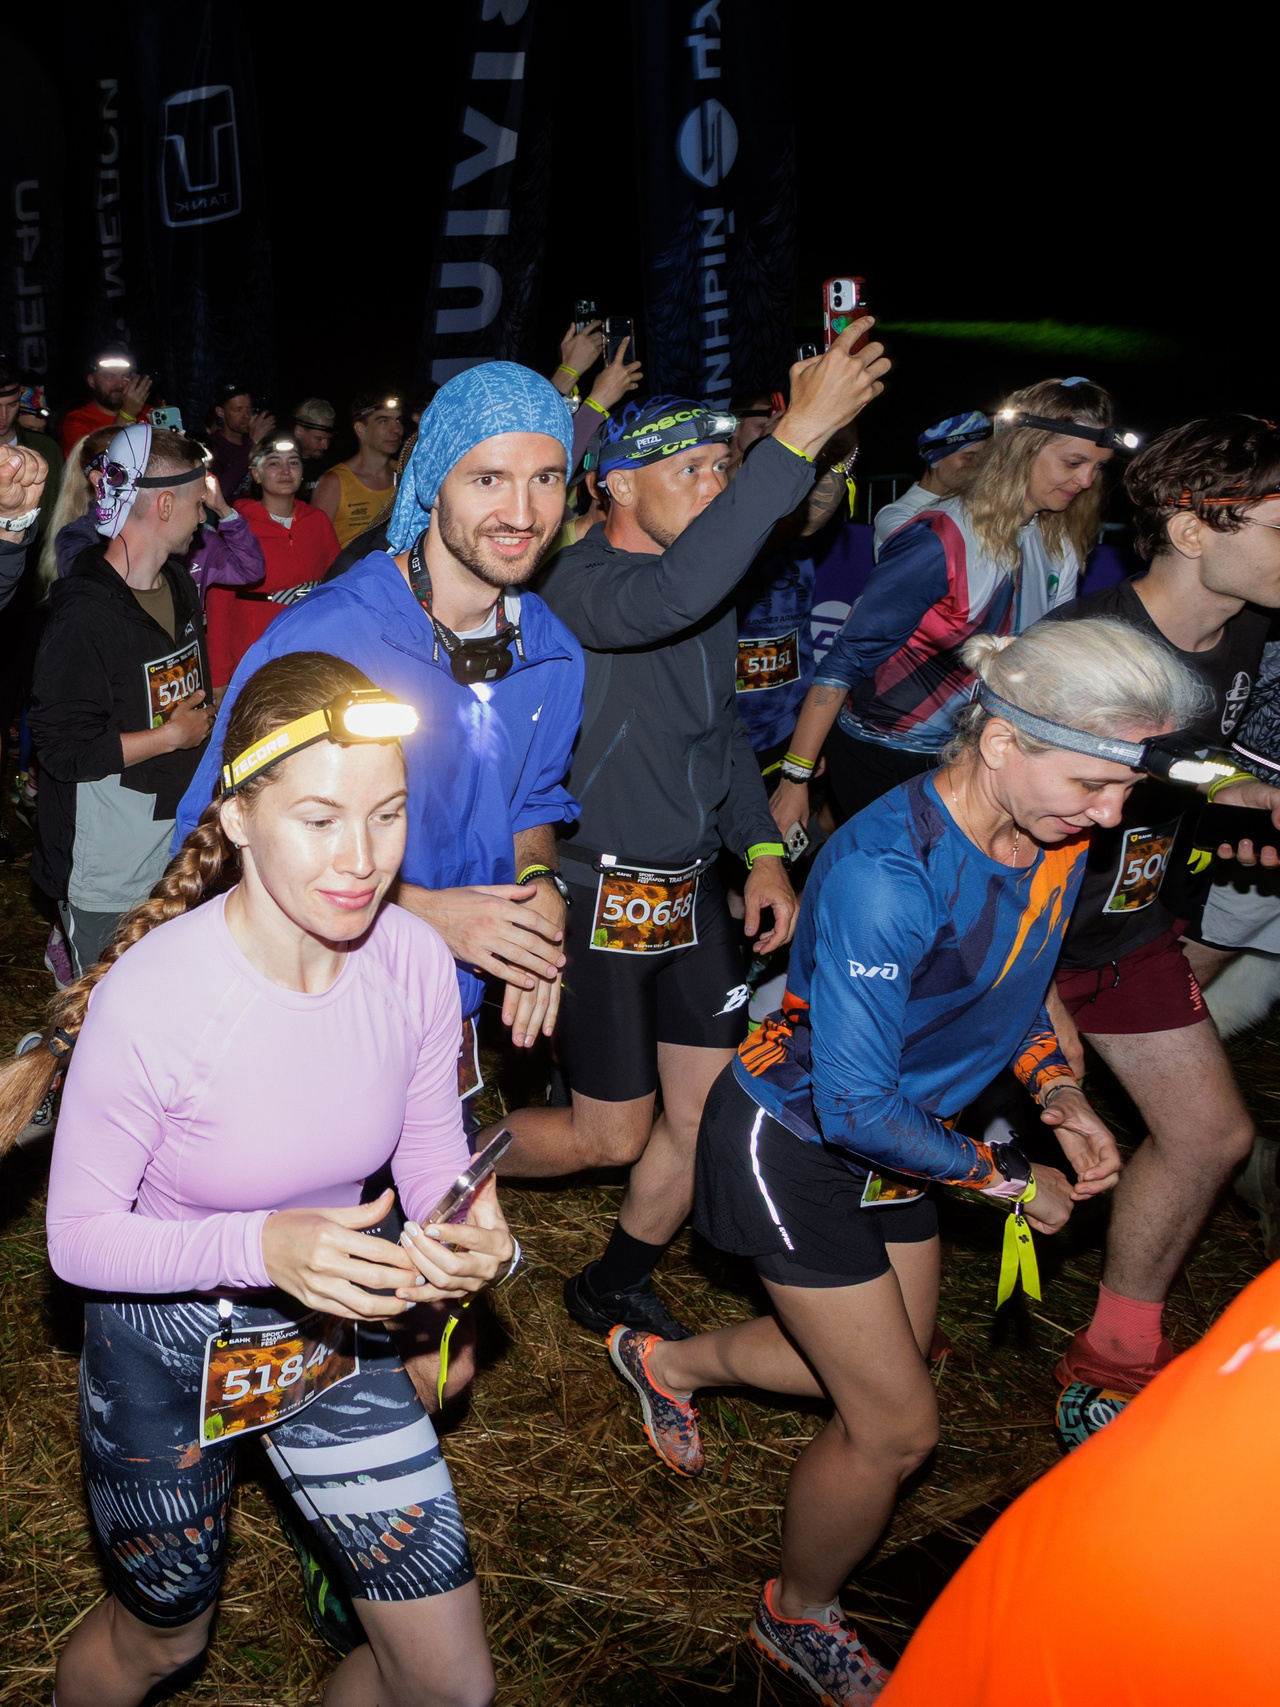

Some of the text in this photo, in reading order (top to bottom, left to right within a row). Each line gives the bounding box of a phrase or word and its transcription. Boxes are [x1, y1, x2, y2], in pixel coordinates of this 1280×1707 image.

[637, 435, 662, 449] PETZL
[946, 435, 966, 444] ЭРА
[412, 557, 421, 573] LED
[747, 650, 791, 673] 51151
[160, 668, 200, 707] 52102
[602, 893, 693, 926] 50658
[229, 1337, 251, 1345] БАНК
[262, 1330, 284, 1338] SPORT
[265, 1330, 299, 1342] MARAFON
[222, 1341, 337, 1401] 5184
